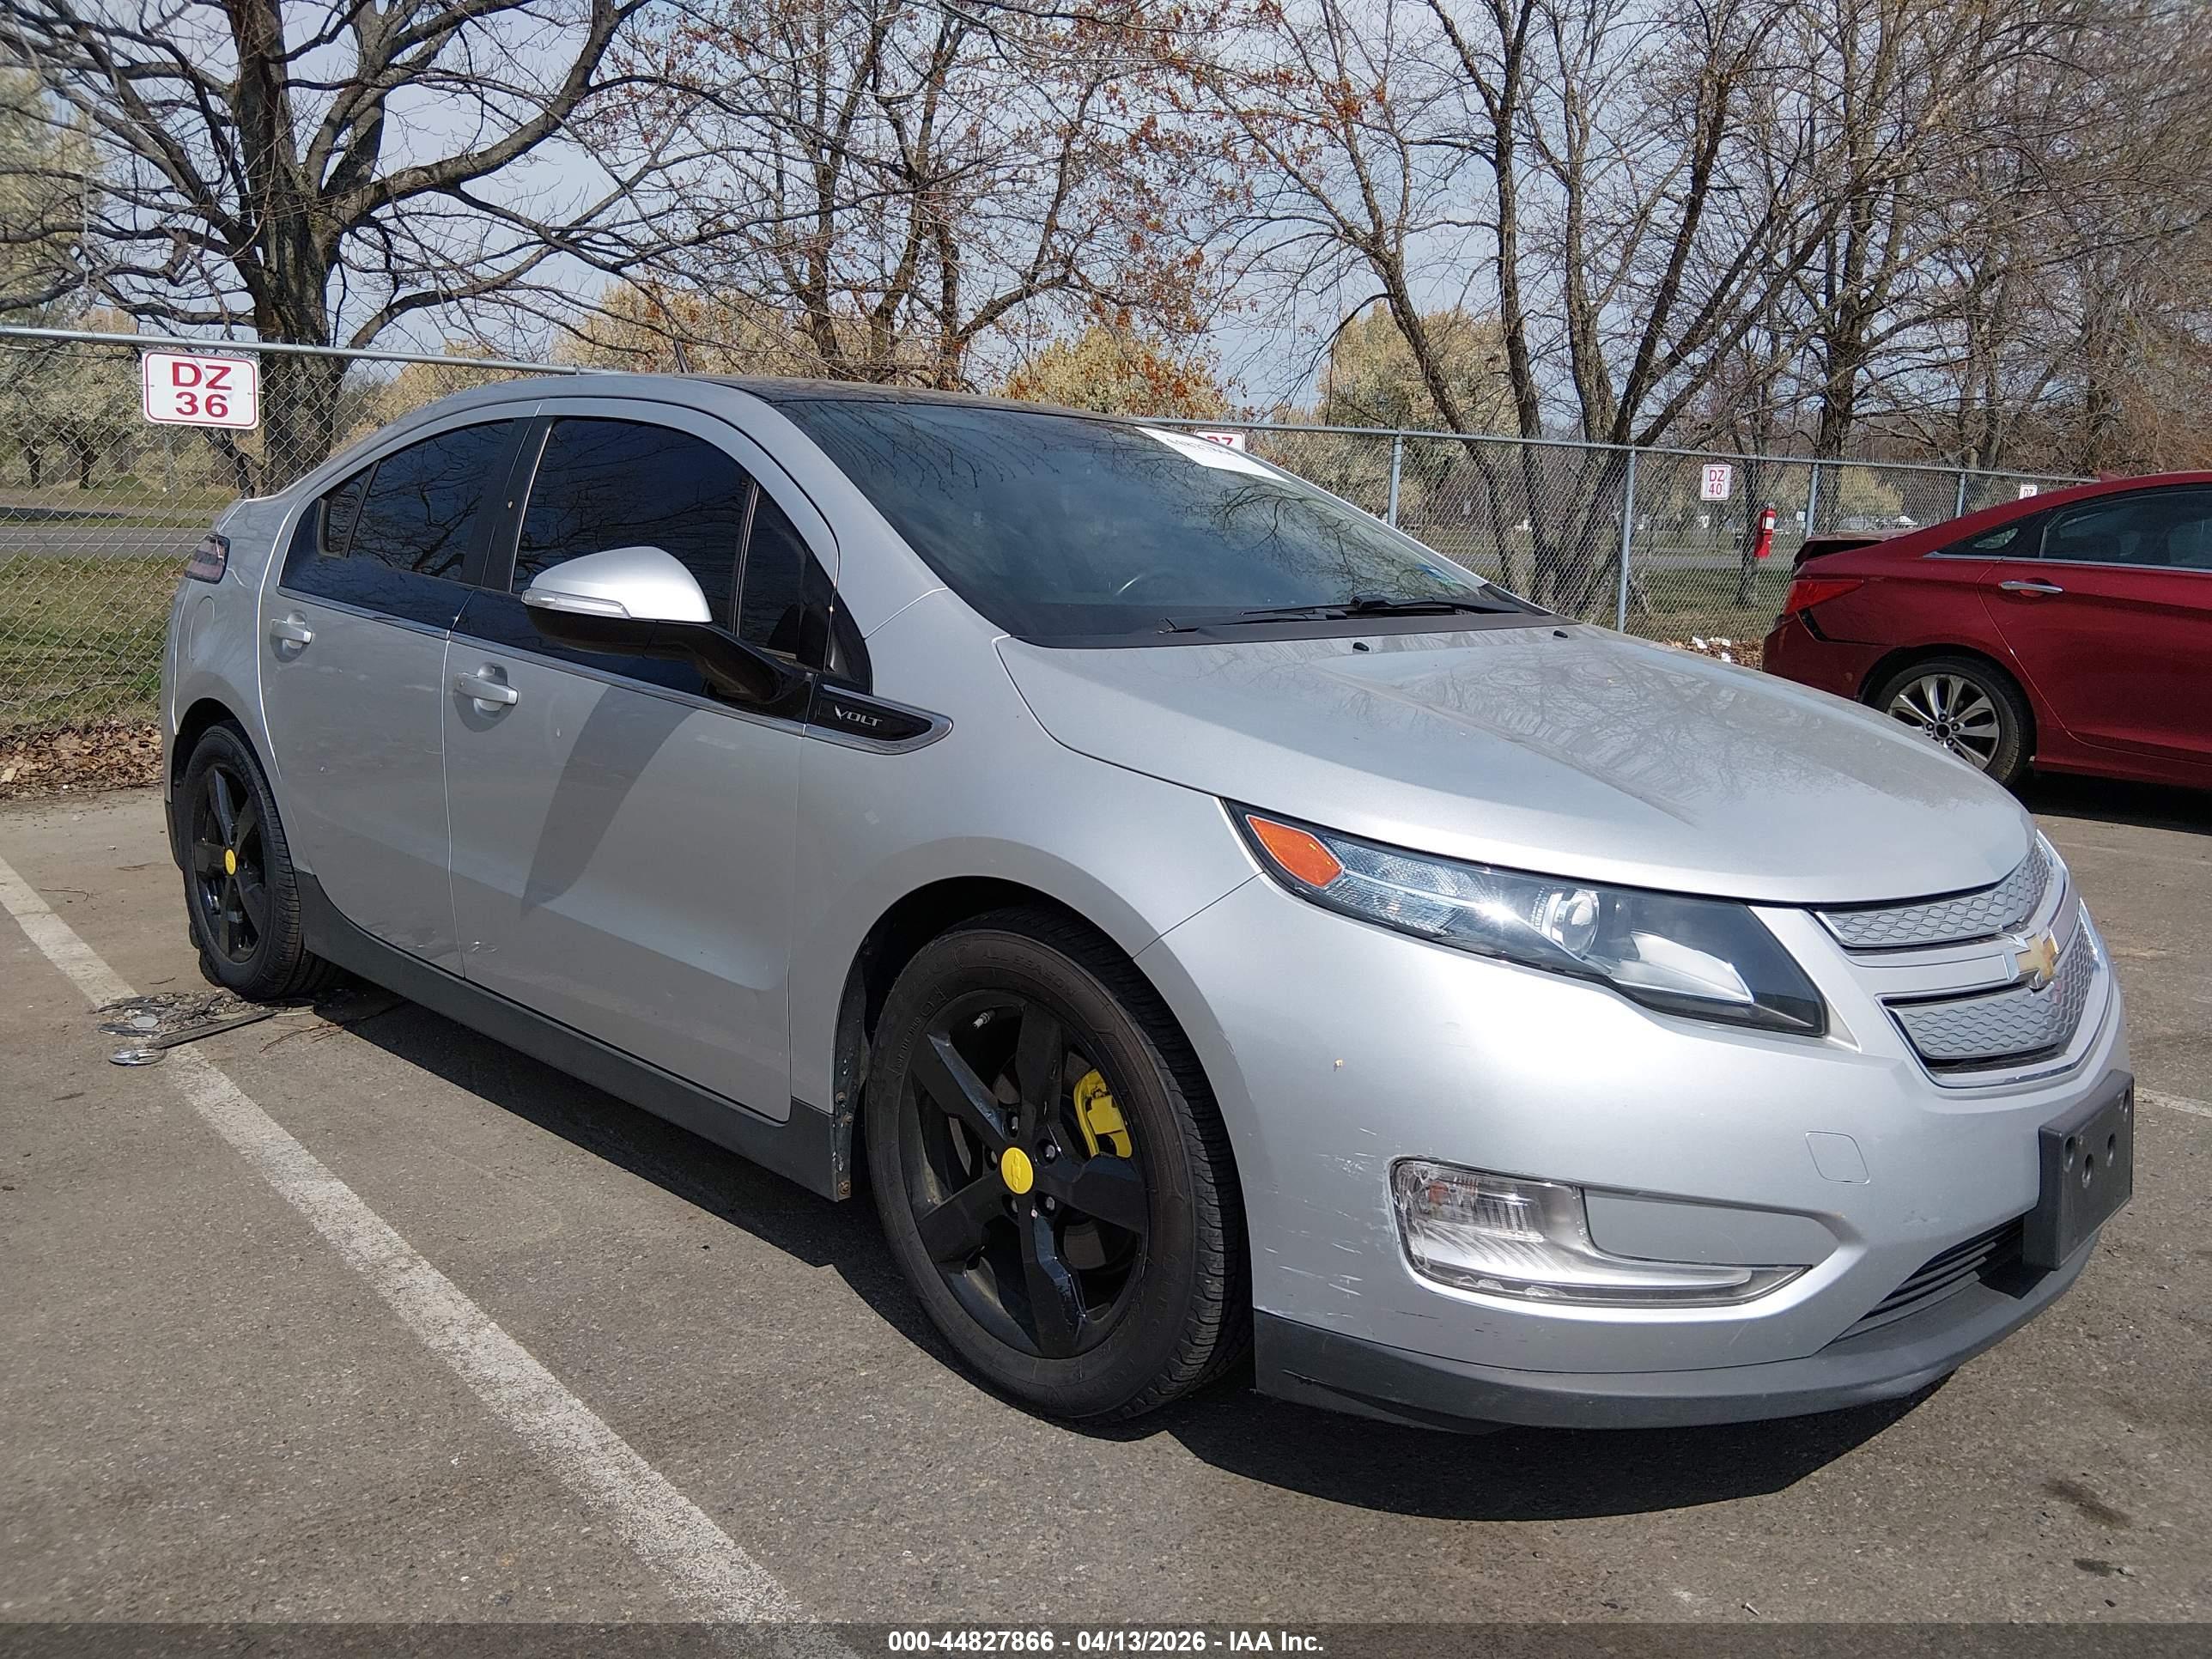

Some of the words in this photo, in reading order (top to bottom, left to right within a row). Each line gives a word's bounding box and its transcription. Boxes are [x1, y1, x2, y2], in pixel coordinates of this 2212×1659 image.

[172, 362, 232, 391] DZ
[175, 392, 229, 417] 36
[1709, 470, 1725, 482] DZ
[1708, 483, 1723, 495] 40
[835, 704, 884, 728] VOLT
